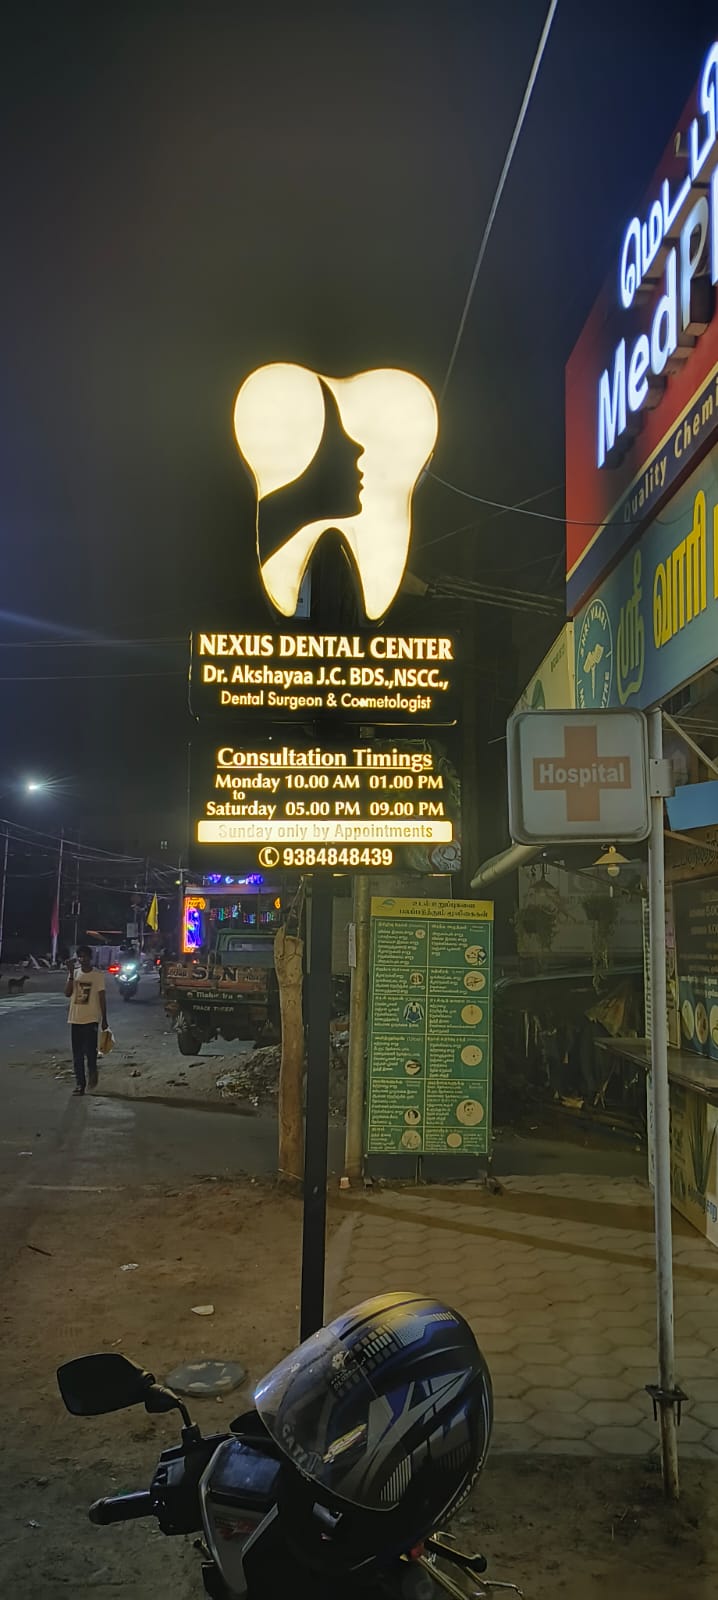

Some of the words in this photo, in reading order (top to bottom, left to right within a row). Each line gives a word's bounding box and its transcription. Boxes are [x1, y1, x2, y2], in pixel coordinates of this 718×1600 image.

[624, 455, 667, 522] Quality
[653, 489, 707, 649] வாரி
[199, 633, 274, 656] NEXUS
[279, 634, 365, 659] DENTAL
[370, 636, 454, 660] CENTER
[203, 665, 228, 684] Dr.
[231, 664, 313, 689] Akshayaa
[316, 667, 346, 686] J.C.
[221, 690, 264, 706] Dental
[267, 691, 322, 710] Surgeon
[326, 693, 338, 707] &
[217, 747, 347, 767] Consultation
[352, 748, 433, 772] Timings
[215, 773, 280, 793] Monday
[285, 774, 329, 790] 10.00
[332, 774, 360, 790] AM
[369, 774, 414, 790] 01.00
[418, 775, 444, 790] PM
[539, 763, 625, 787] Hospital
[232, 789, 246, 801] to
[206, 801, 277, 820] Saturday
[285, 801, 330, 816] 05.00
[335, 801, 361, 816] PM
[369, 801, 414, 817] 09.00
[418, 801, 445, 816] PM
[218, 823, 272, 841] Sunday
[277, 823, 308, 841] only
[313, 823, 330, 841] by
[334, 823, 433, 841] Appointments
[283, 848, 393, 866] 9384848439
